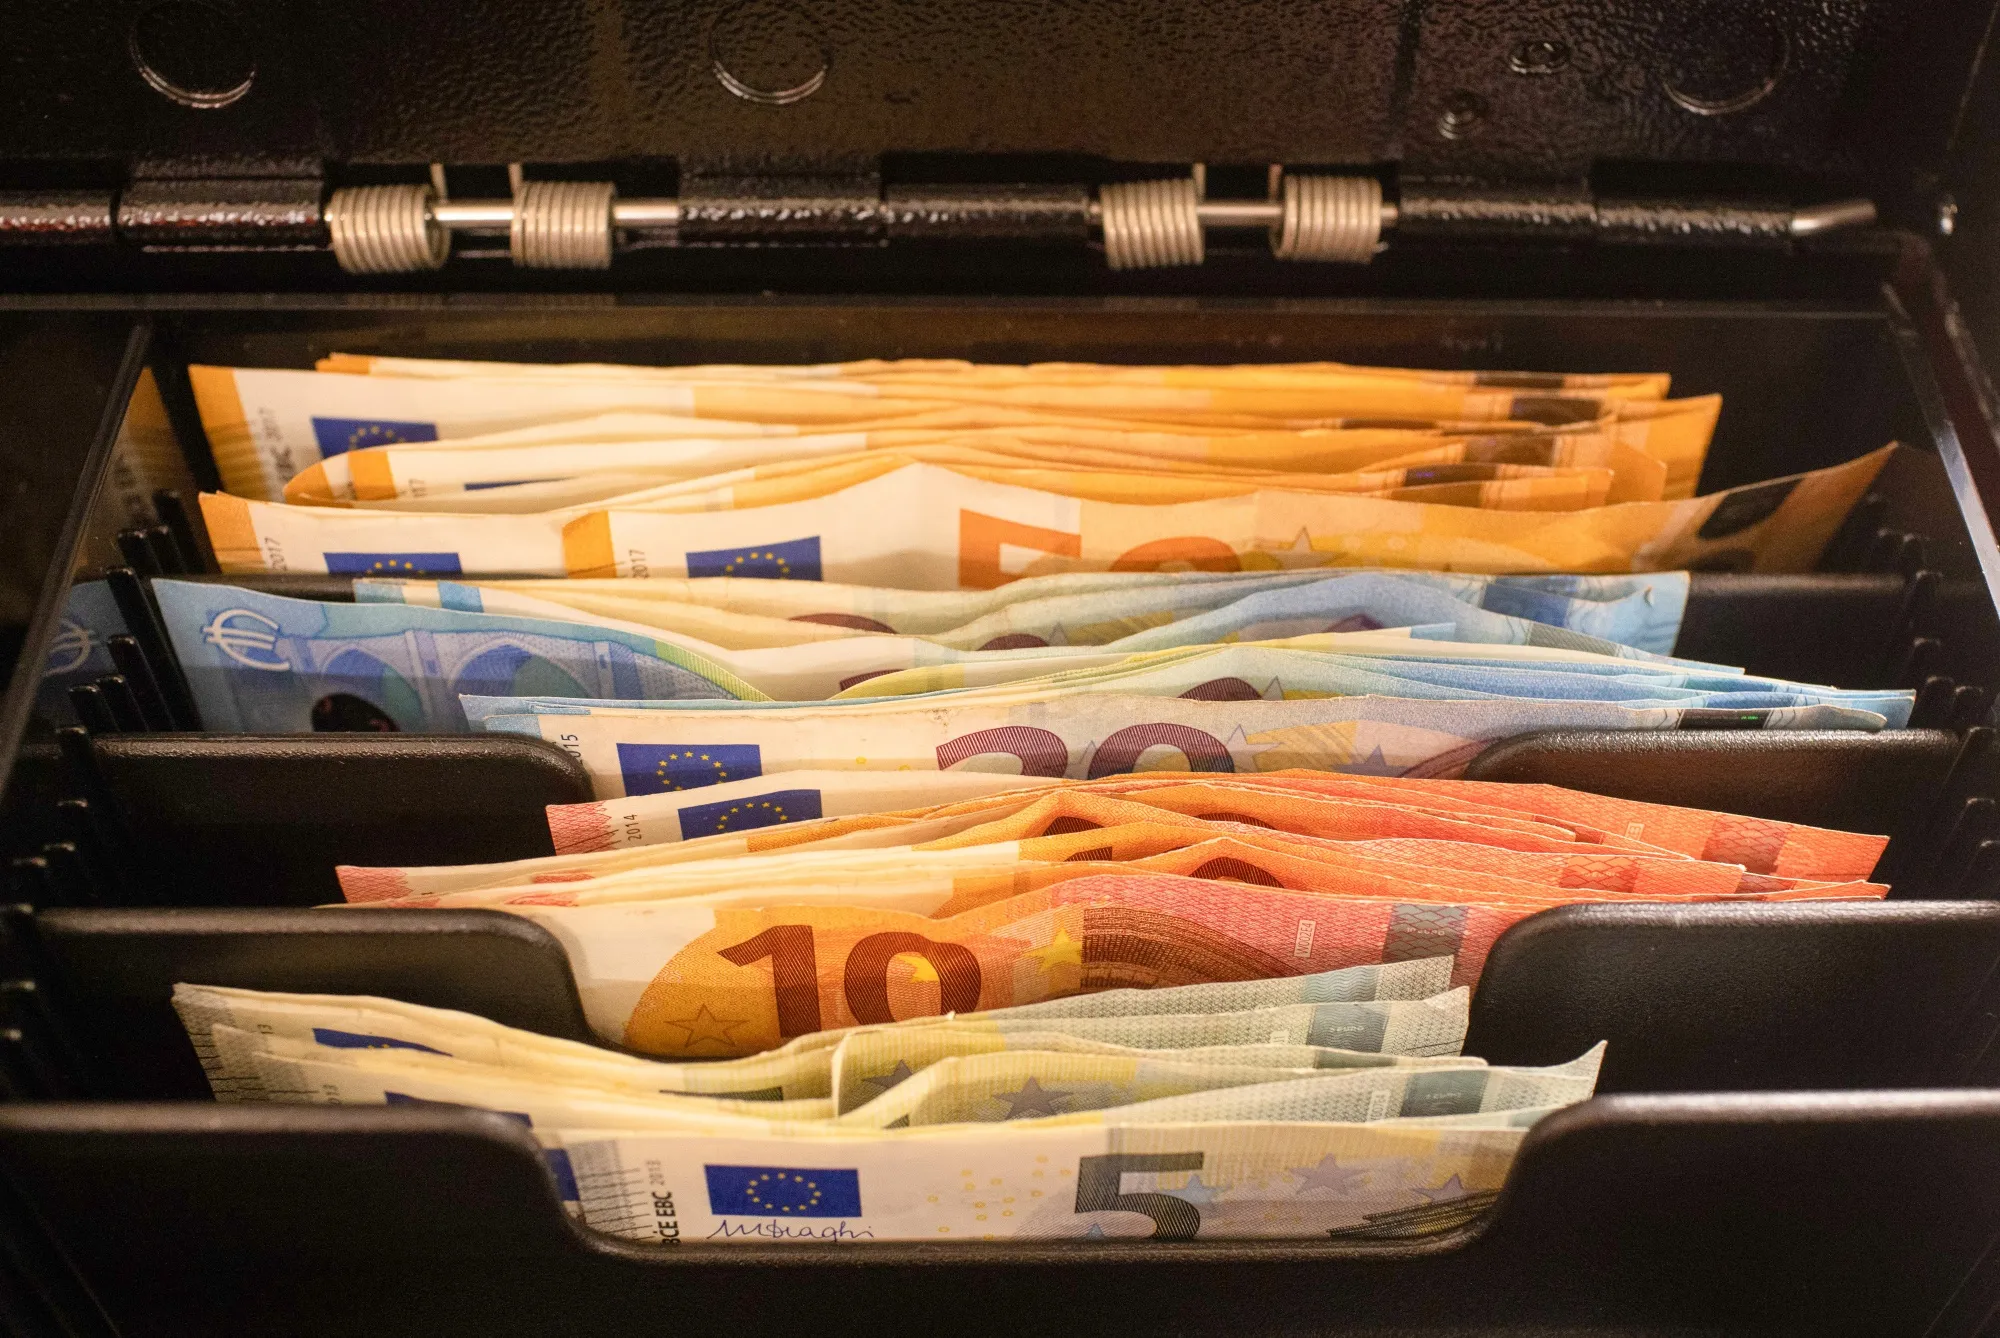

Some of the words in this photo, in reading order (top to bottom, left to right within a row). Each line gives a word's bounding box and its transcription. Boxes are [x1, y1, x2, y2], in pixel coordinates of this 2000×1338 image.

[263, 537, 289, 572] 2017
[628, 548, 650, 579] 2017
[560, 733, 583, 760] 015
[623, 813, 643, 841] 2014
[1294, 922, 1315, 956] W002E4
[716, 924, 982, 1039] 10
[651, 1190, 677, 1217] EBC
[1074, 1151, 1204, 1243] 5
